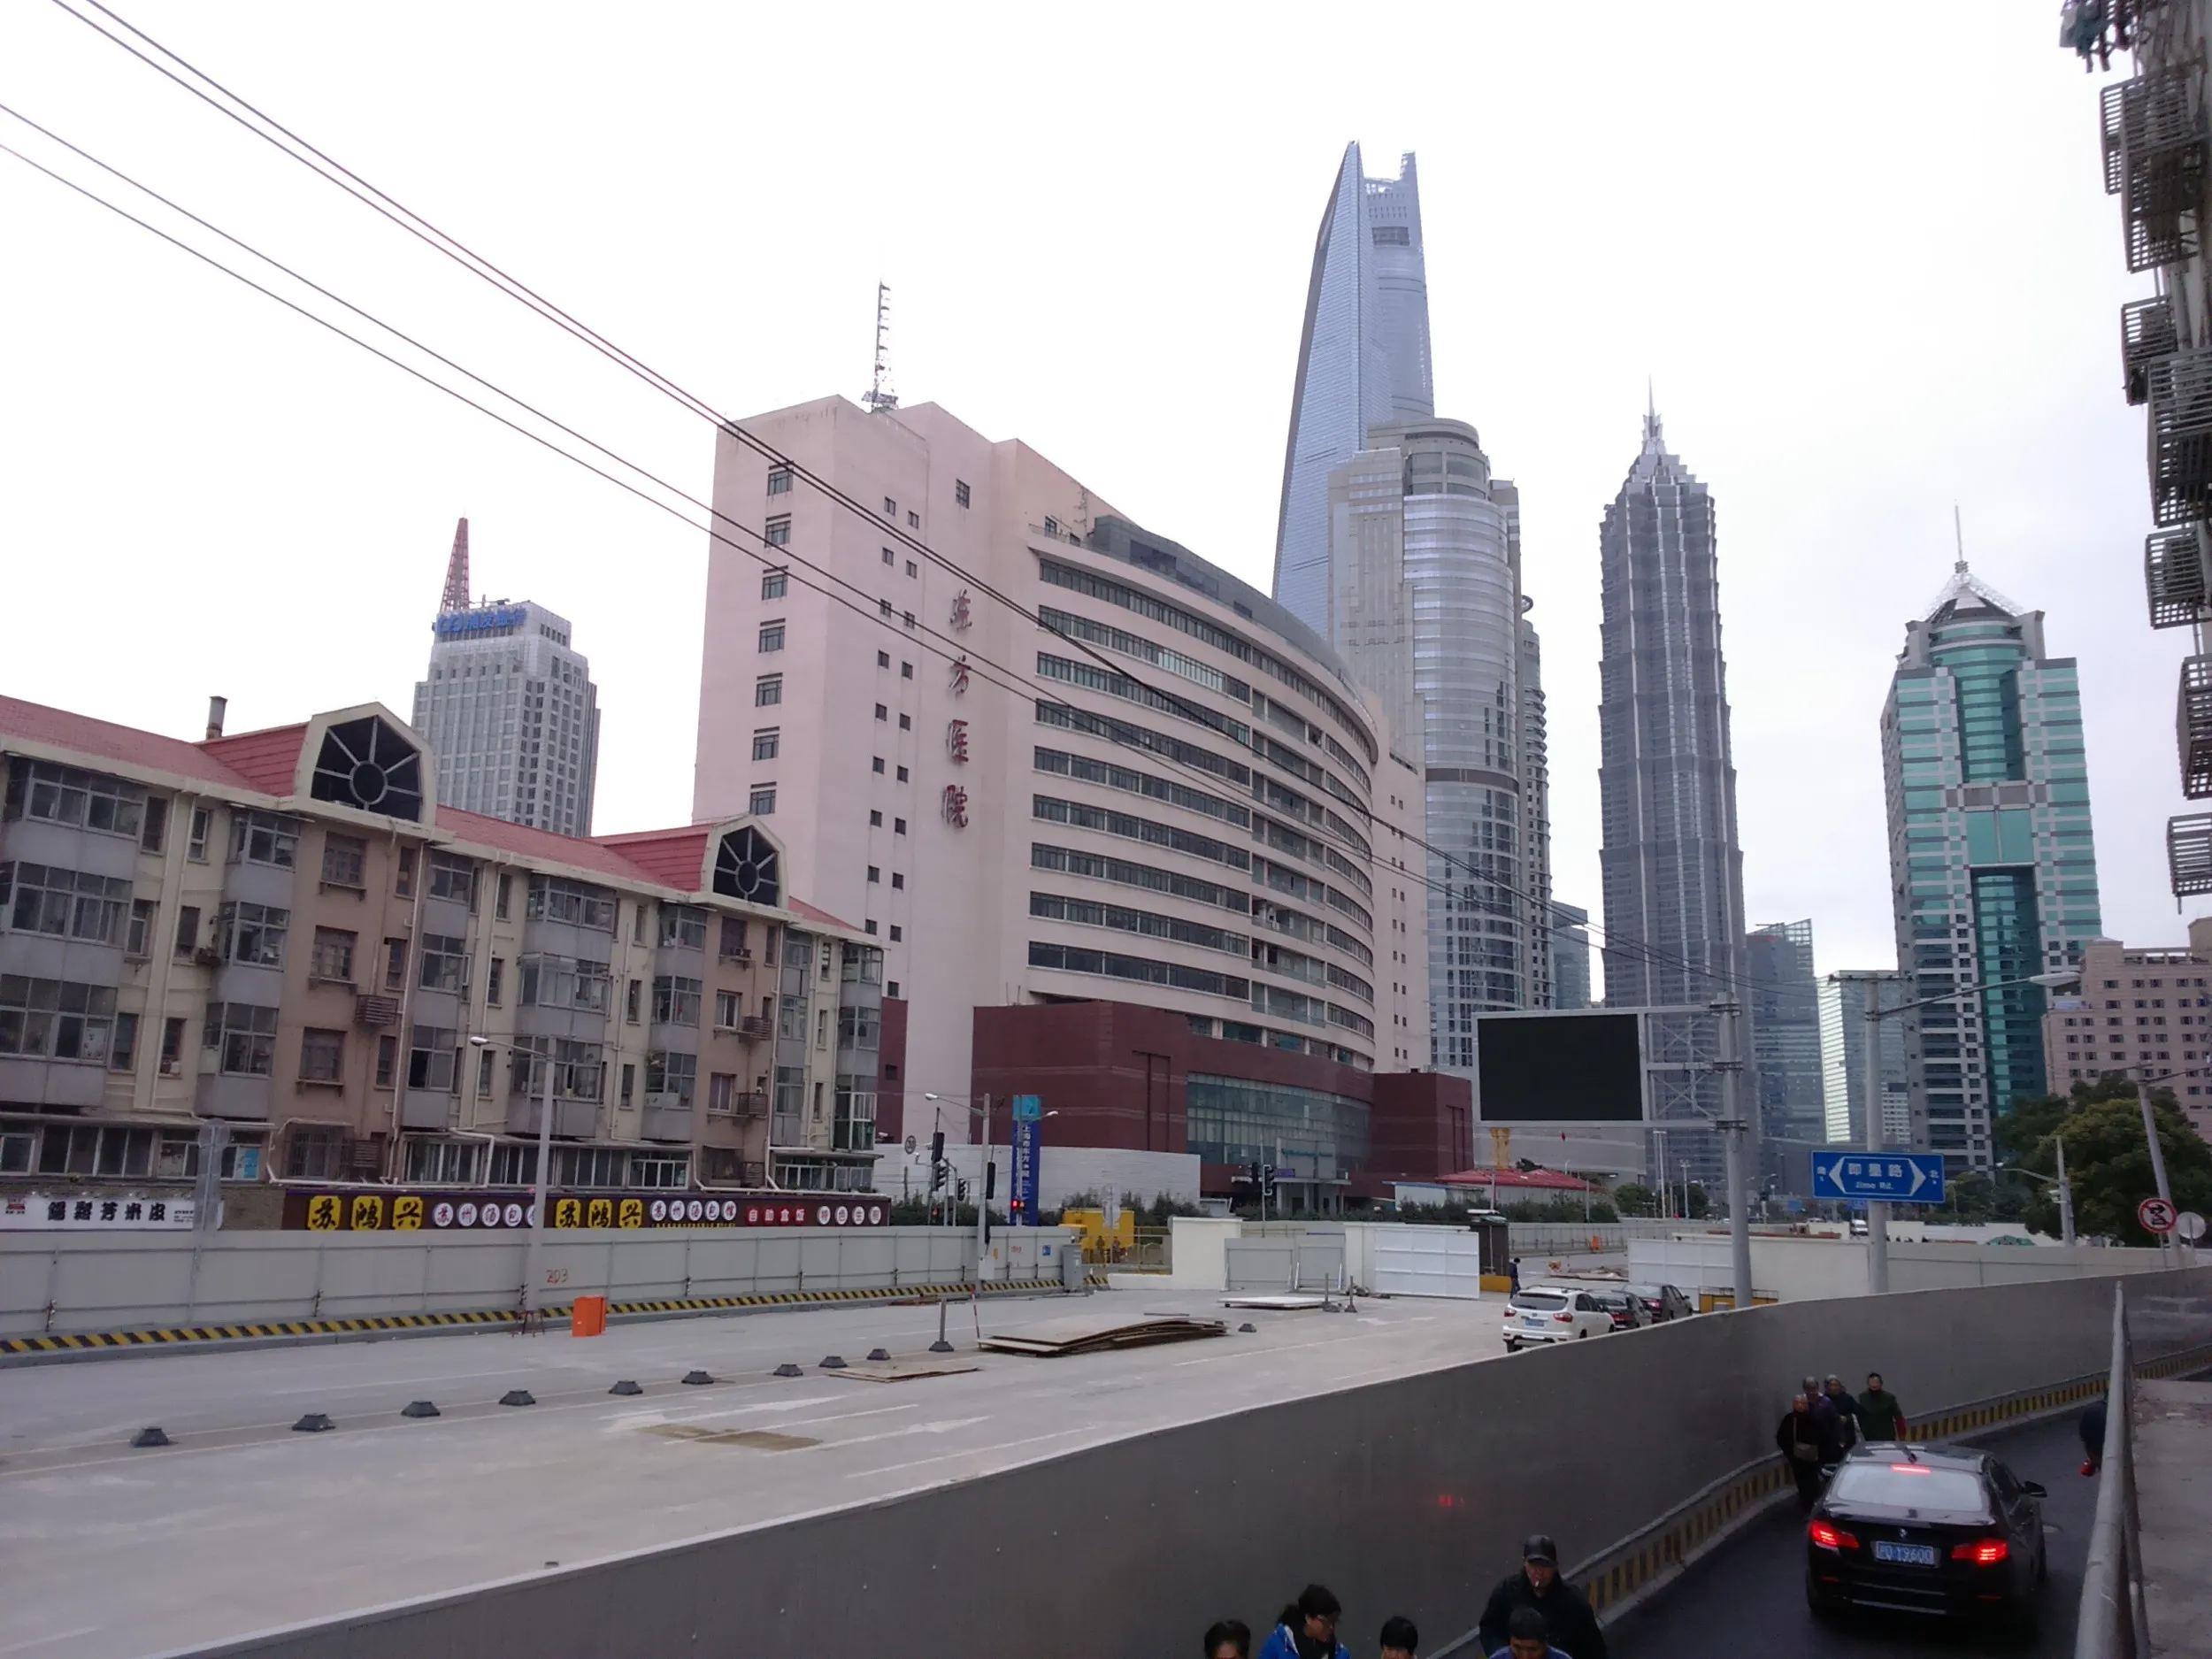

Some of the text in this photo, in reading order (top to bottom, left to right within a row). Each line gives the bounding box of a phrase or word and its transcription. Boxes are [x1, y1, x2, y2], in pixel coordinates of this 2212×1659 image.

[311, 1198, 421, 1229] 苏鸿兴
[434, 1204, 534, 1226] 苏州汤包
[560, 1201, 641, 1228] 苏鸿兴
